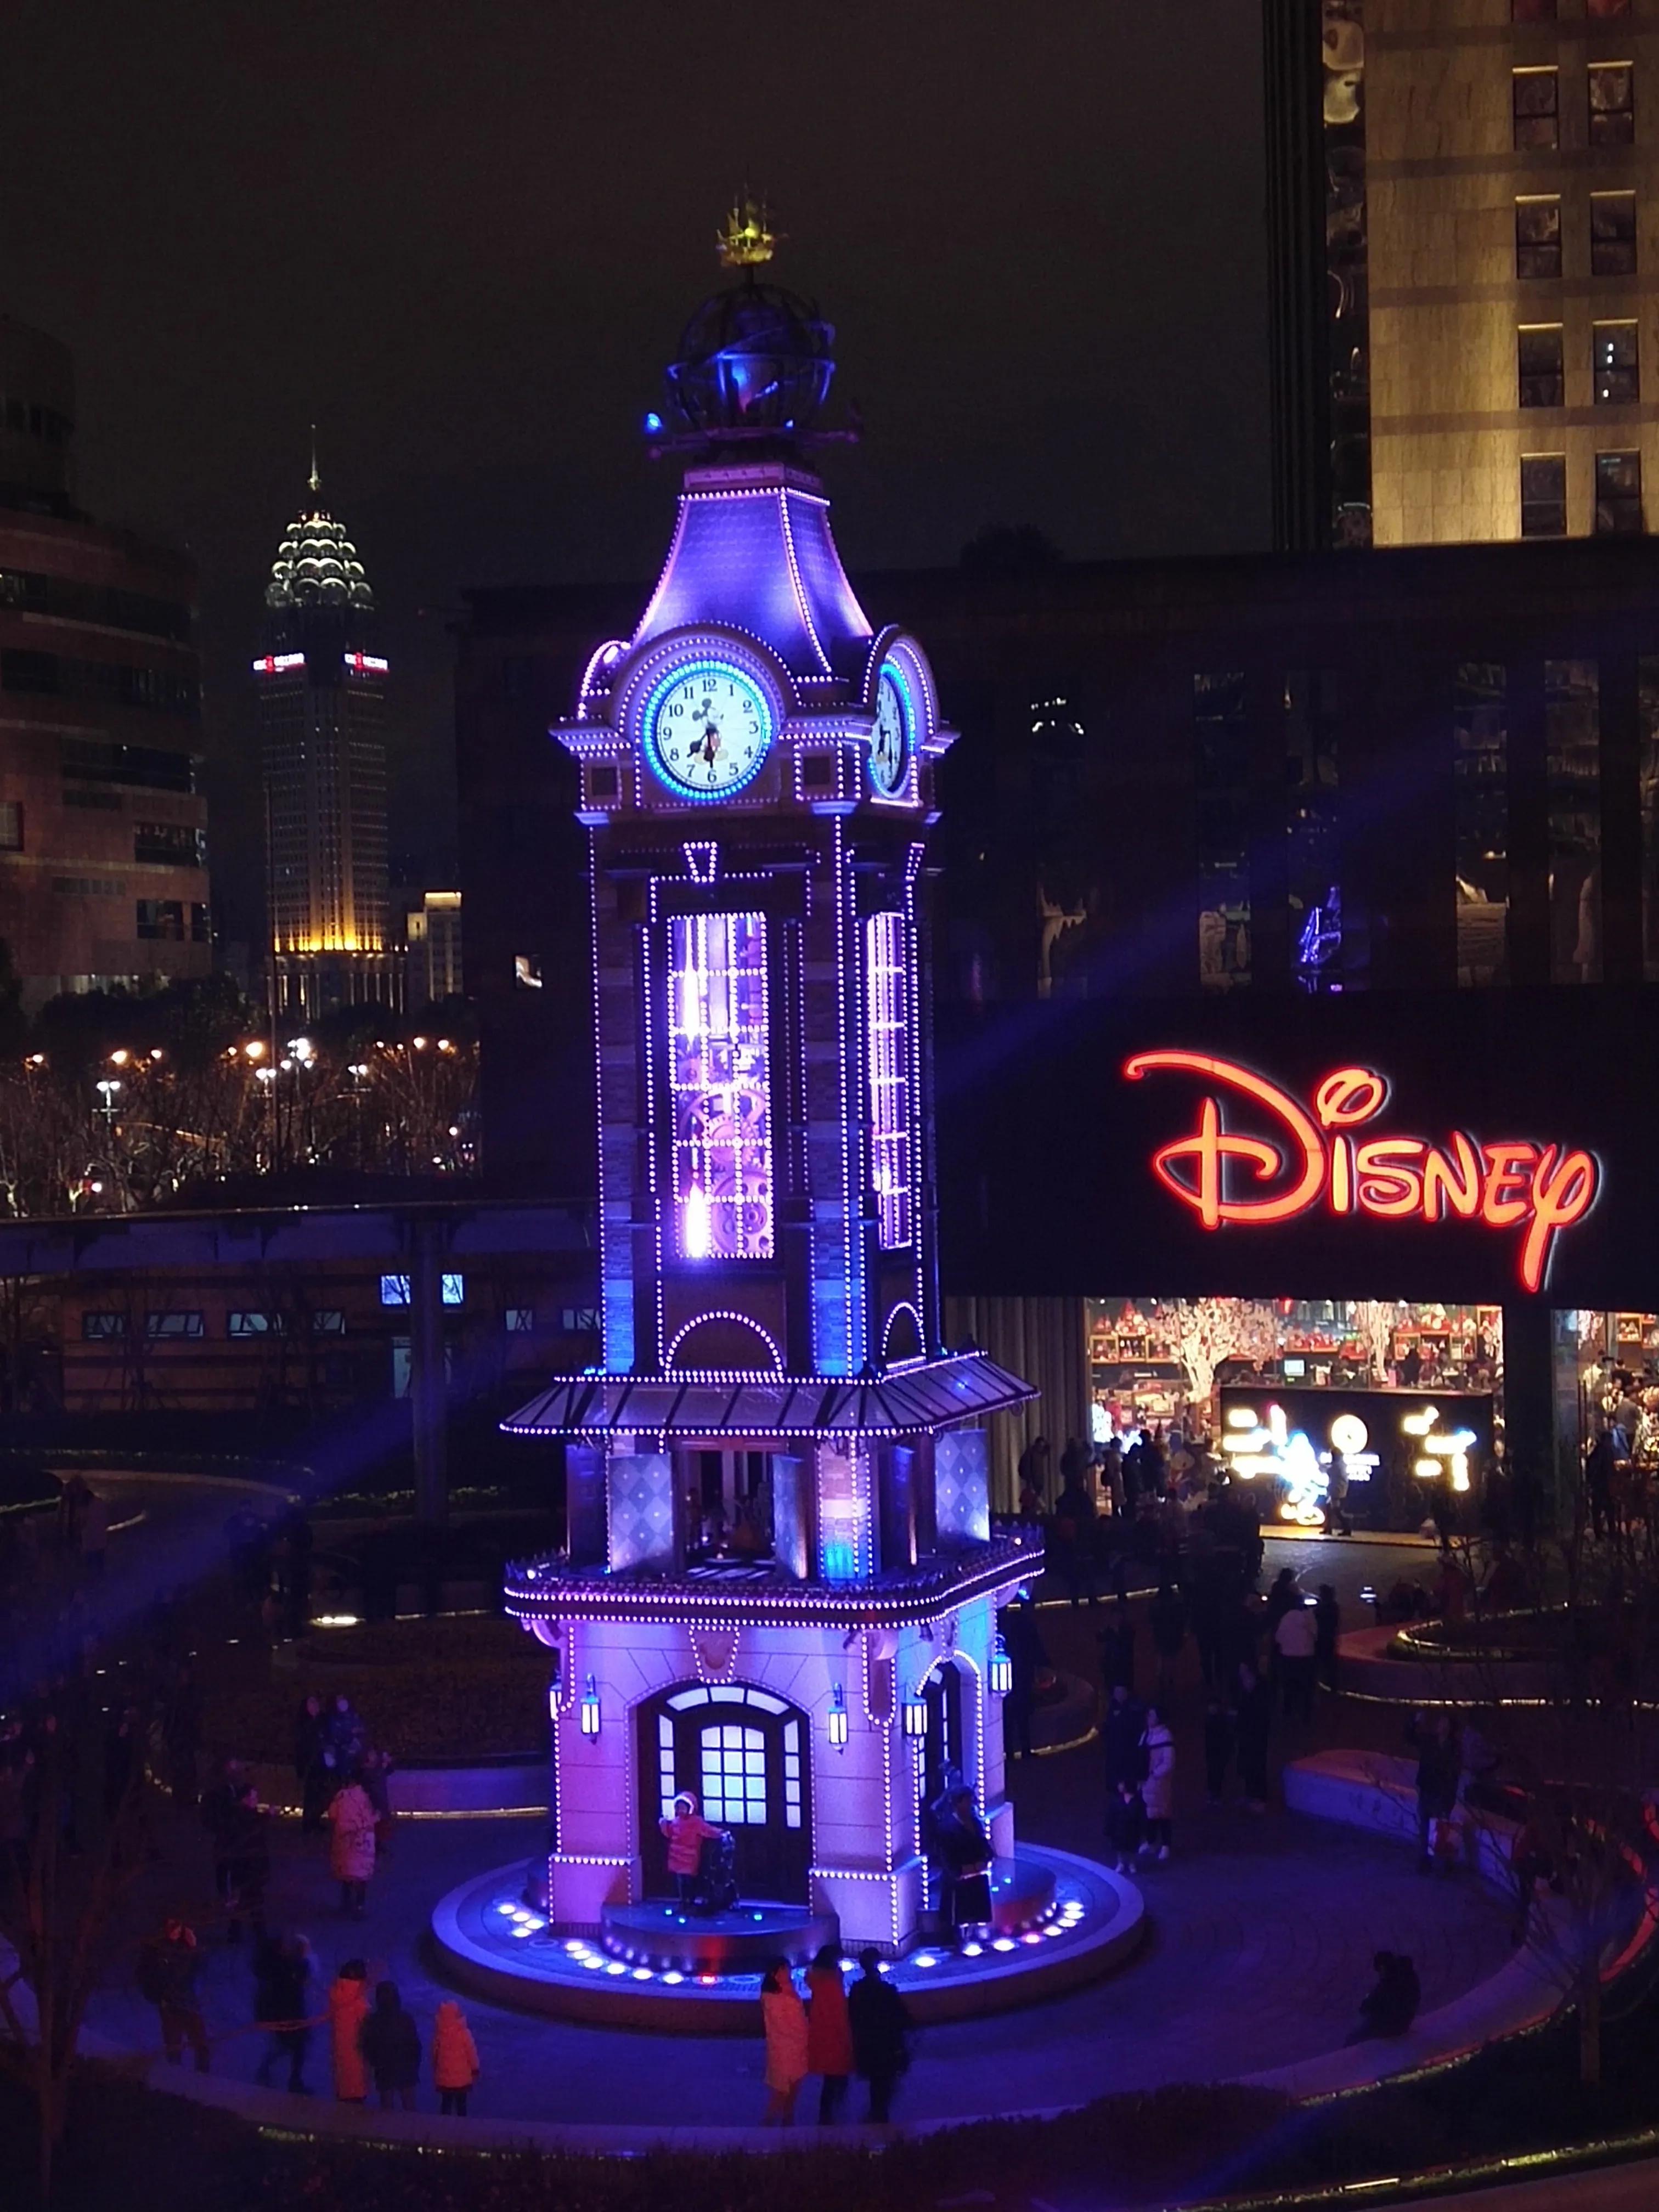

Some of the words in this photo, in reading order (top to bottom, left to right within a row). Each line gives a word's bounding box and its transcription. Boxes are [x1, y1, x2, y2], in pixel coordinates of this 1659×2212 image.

[703, 679, 717, 692] 12
[729, 684, 733, 696] 1
[684, 687, 693, 699] 11
[669, 704, 684, 717] 10
[743, 700, 753, 713] 2
[663, 727, 672, 740] 9
[749, 721, 758, 734] 3
[670, 748, 679, 761] 8
[744, 746, 753, 758] 4
[686, 764, 696, 777] 7
[729, 763, 739, 776] 5
[708, 770, 716, 783] 6
